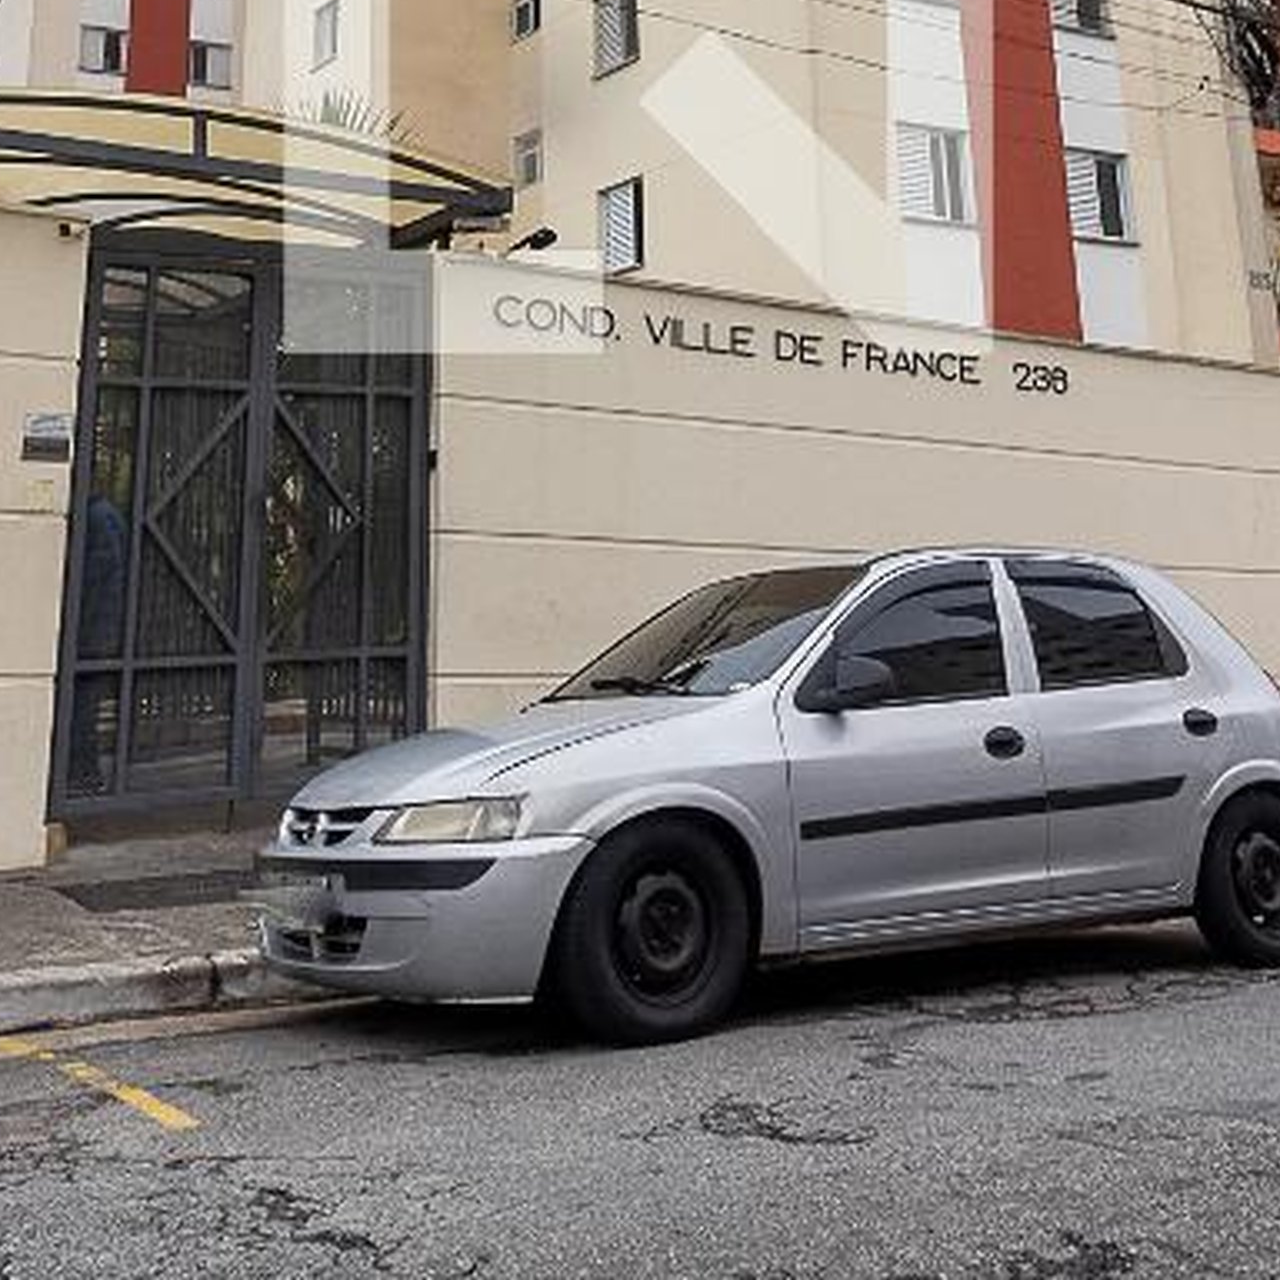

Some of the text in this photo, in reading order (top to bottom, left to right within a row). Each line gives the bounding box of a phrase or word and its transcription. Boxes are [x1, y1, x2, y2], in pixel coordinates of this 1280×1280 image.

[494, 294, 621, 342] COND.
[643, 309, 757, 358] VILLE
[774, 329, 823, 366] DE
[841, 338, 982, 385] FRANCE
